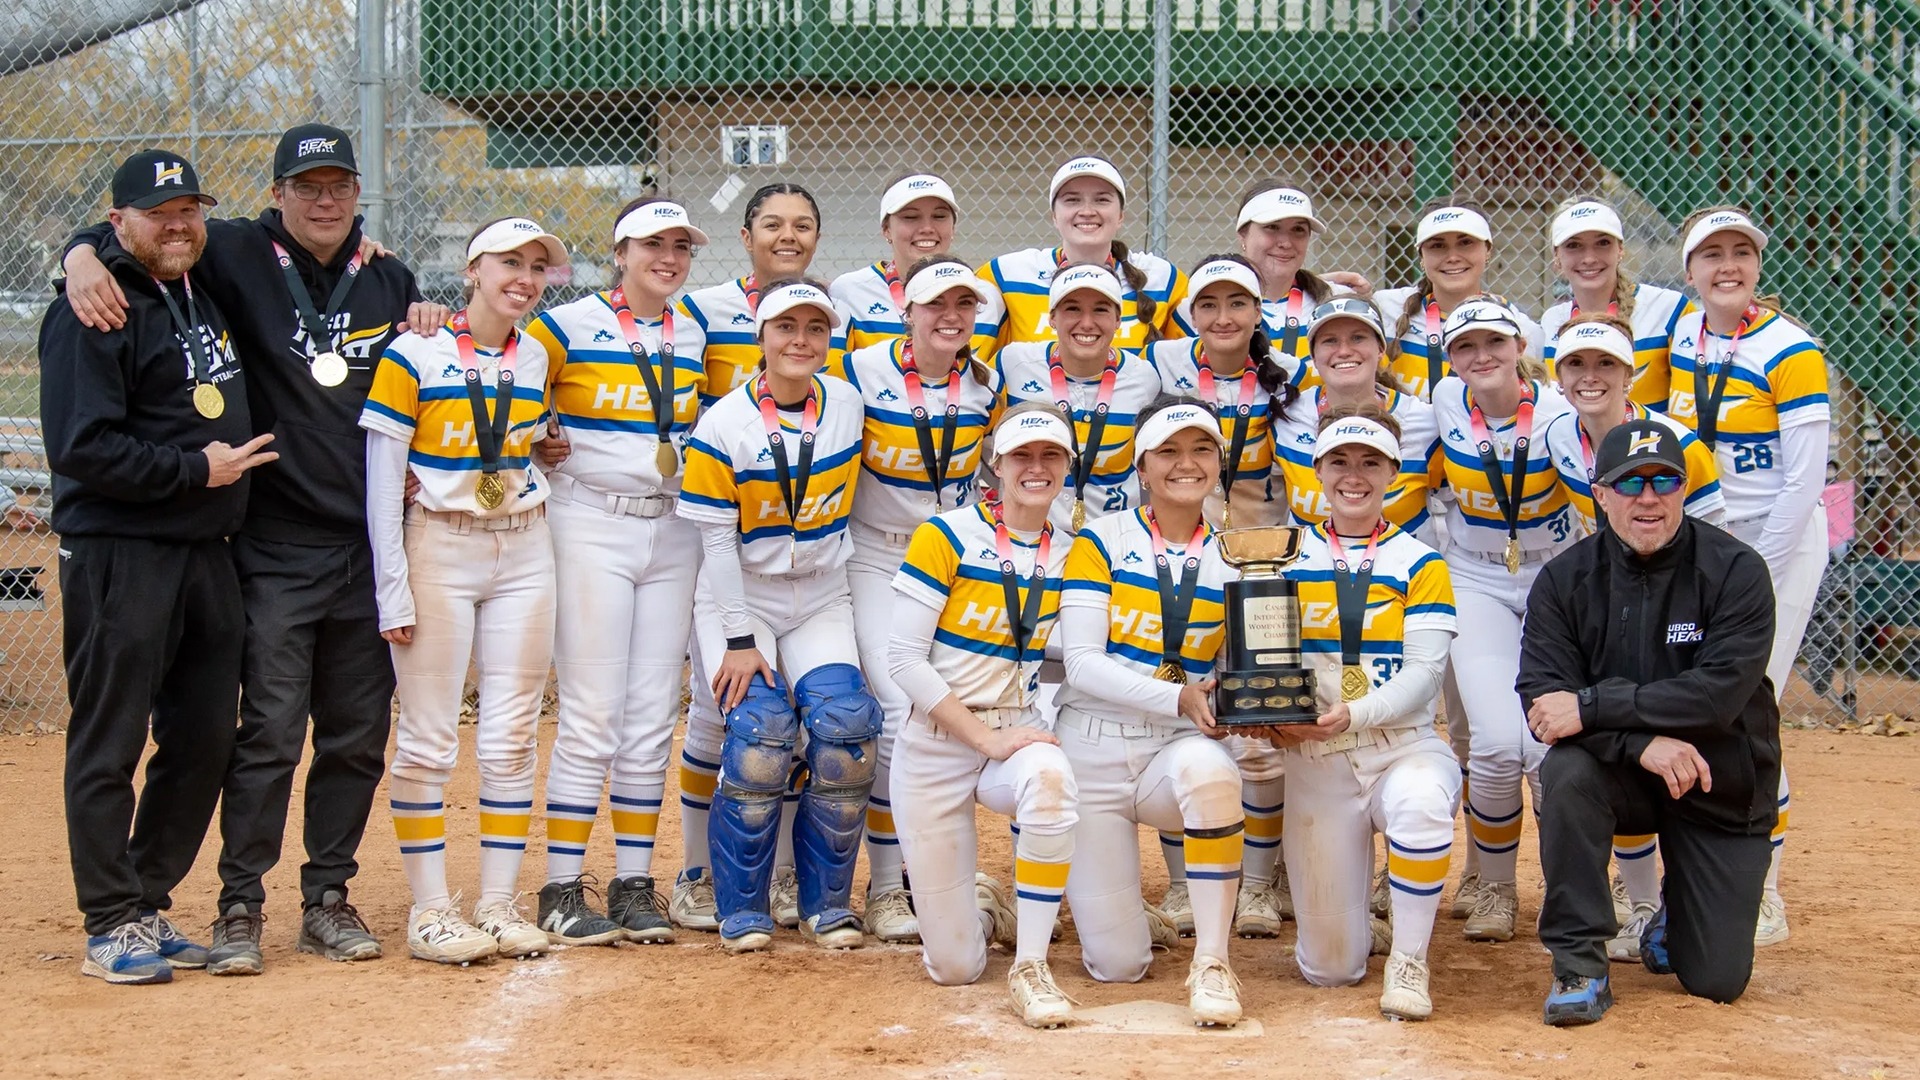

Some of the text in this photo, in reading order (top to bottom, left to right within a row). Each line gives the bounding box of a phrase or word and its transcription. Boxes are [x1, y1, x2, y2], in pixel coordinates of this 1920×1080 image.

[299, 139, 339, 153] HEAT
[1070, 161, 1099, 171] HEAT
[154, 161, 184, 187] H
[908, 180, 938, 189] HEAT
[1279, 194, 1306, 204] HEAT
[655, 207, 683, 217] HEAT
[1433, 212, 1464, 223] HEAT
[1571, 207, 1599, 218] HEAT
[1710, 215, 1741, 225] HEAT
[514, 222, 541, 233] HEAT
[935, 267, 964, 277] HEAT
[1206, 265, 1236, 275] HEAT
[1064, 271, 1104, 285] HEAT
[788, 288, 820, 297] HEAT
[1576, 327, 1609, 337] HEAT
[592, 383, 698, 413] HET
[1167, 410, 1199, 421] HEAT
[1020, 417, 1054, 426] HEAT
[1336, 425, 1381, 436] HEAT
[1628, 430, 1663, 457] H
[867, 436, 981, 471] HET
[1732, 444, 1773, 474] 28
[1103, 487, 1128, 512] 21
[1450, 482, 1556, 515] HET
[957, 601, 1056, 640] HET
[1110, 605, 1225, 649] HET
[1667, 622, 1696, 632] UBCO
[1665, 628, 1704, 644] HEAT
